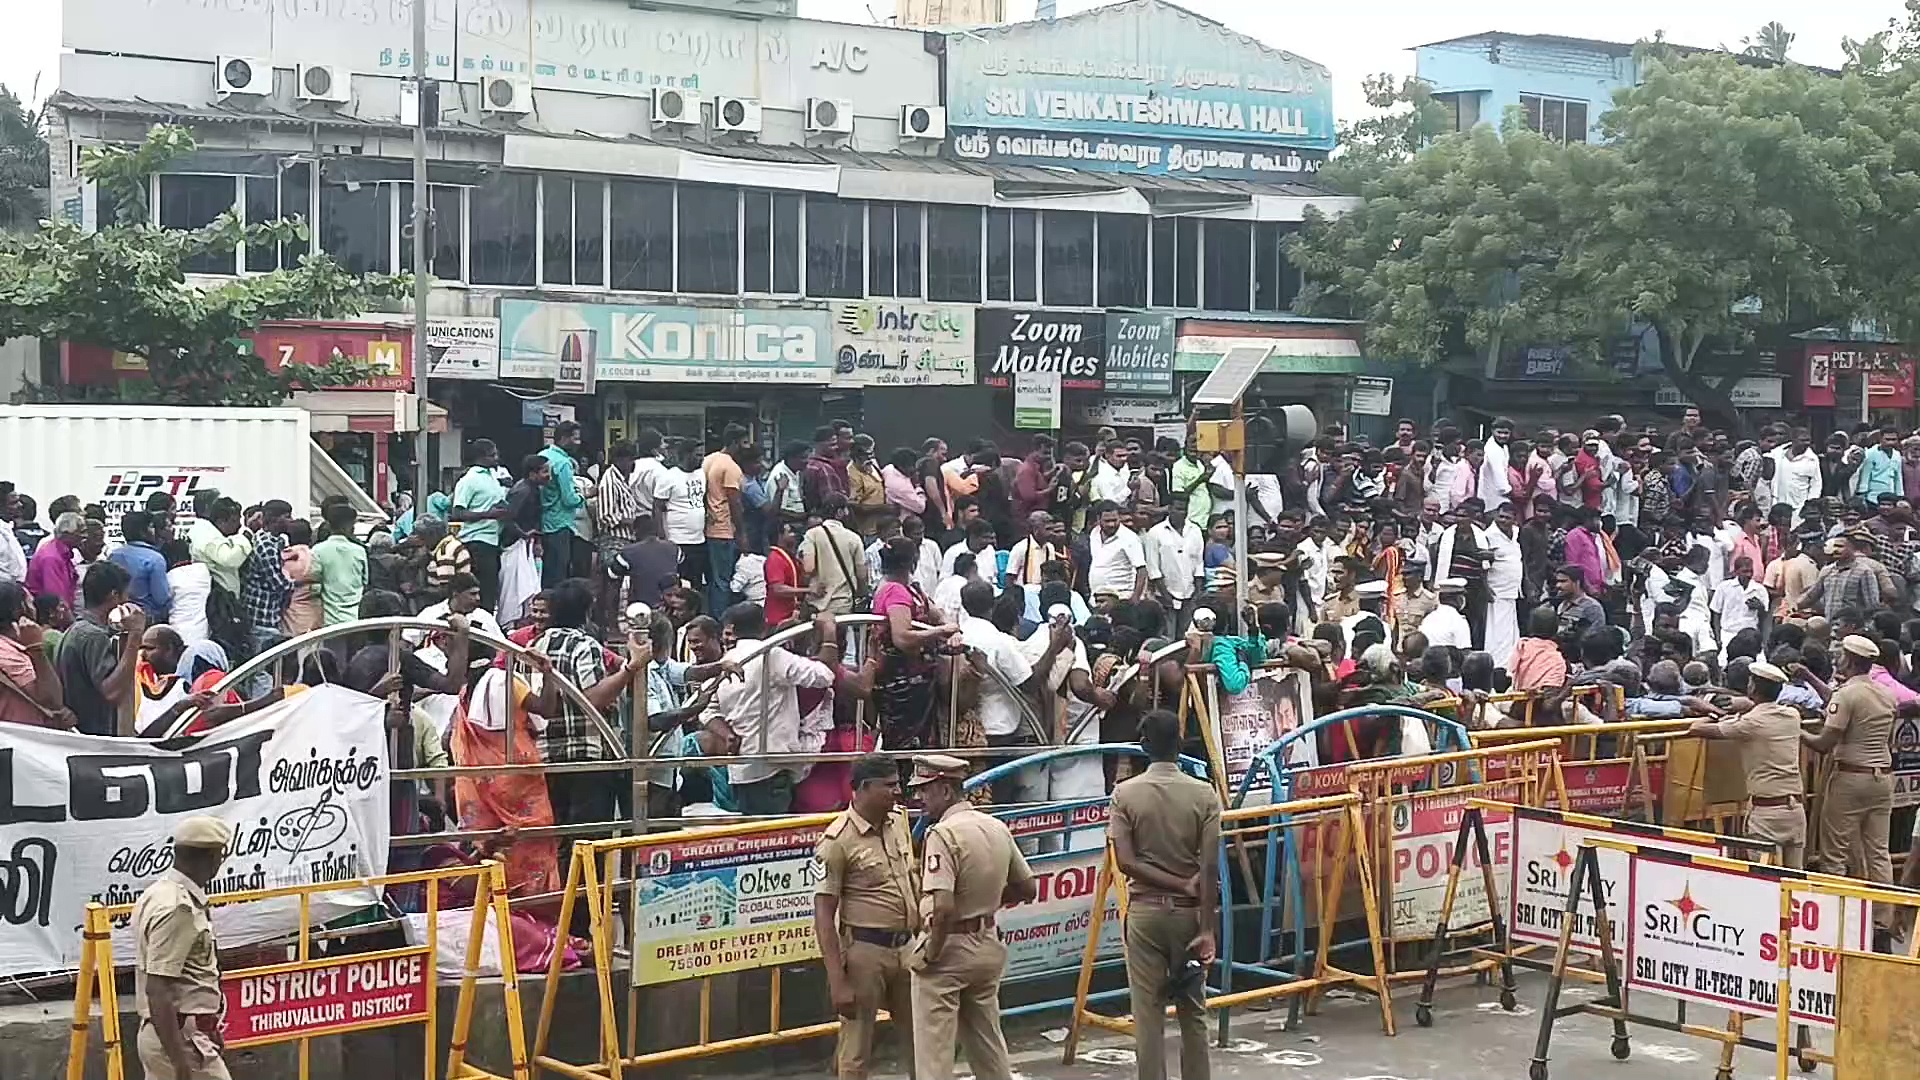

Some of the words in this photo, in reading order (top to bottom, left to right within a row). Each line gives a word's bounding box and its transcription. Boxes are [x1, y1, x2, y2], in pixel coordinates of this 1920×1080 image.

[811, 40, 868, 73] A/C
[985, 87, 1026, 117] SRI
[1033, 90, 1246, 129] VENKATESHWARA
[1251, 105, 1309, 135] HALL
[955, 128, 990, 158] ஸ்ரீ
[996, 134, 1161, 168] வெங்கடேஸ்வரா
[1251, 151, 1302, 172] கூடம்
[611, 311, 816, 362] Konica
[1011, 314, 1082, 343] Zoom
[1117, 317, 1161, 341] Zoom
[835, 345, 909, 374] இன்டர்
[992, 345, 1099, 376] Mobiles
[1106, 344, 1170, 370] Mobiles
[682, 841, 735, 857] GREATER
[738, 836, 788, 850] CHENNAI
[740, 867, 791, 894] Olive
[1527, 859, 1557, 889] SRI
[739, 901, 773, 914] GLOBAL
[776, 895, 811, 909] SCHOOL
[1517, 901, 1536, 926] SRI
[1645, 904, 1678, 935] SRI
[1693, 914, 1745, 946] CITY
[656, 942, 704, 959] DREAM
[709, 937, 726, 951] OF
[240, 966, 341, 1008] DISTRICT
[347, 955, 422, 993] POLICE
[1636, 955, 1657, 981] SRI
[1662, 961, 1689, 987] CITY
[1695, 968, 1743, 998] HI-TECH
[250, 1003, 345, 1032] THIRUVALLUR
[352, 993, 413, 1018] DISTRICT
